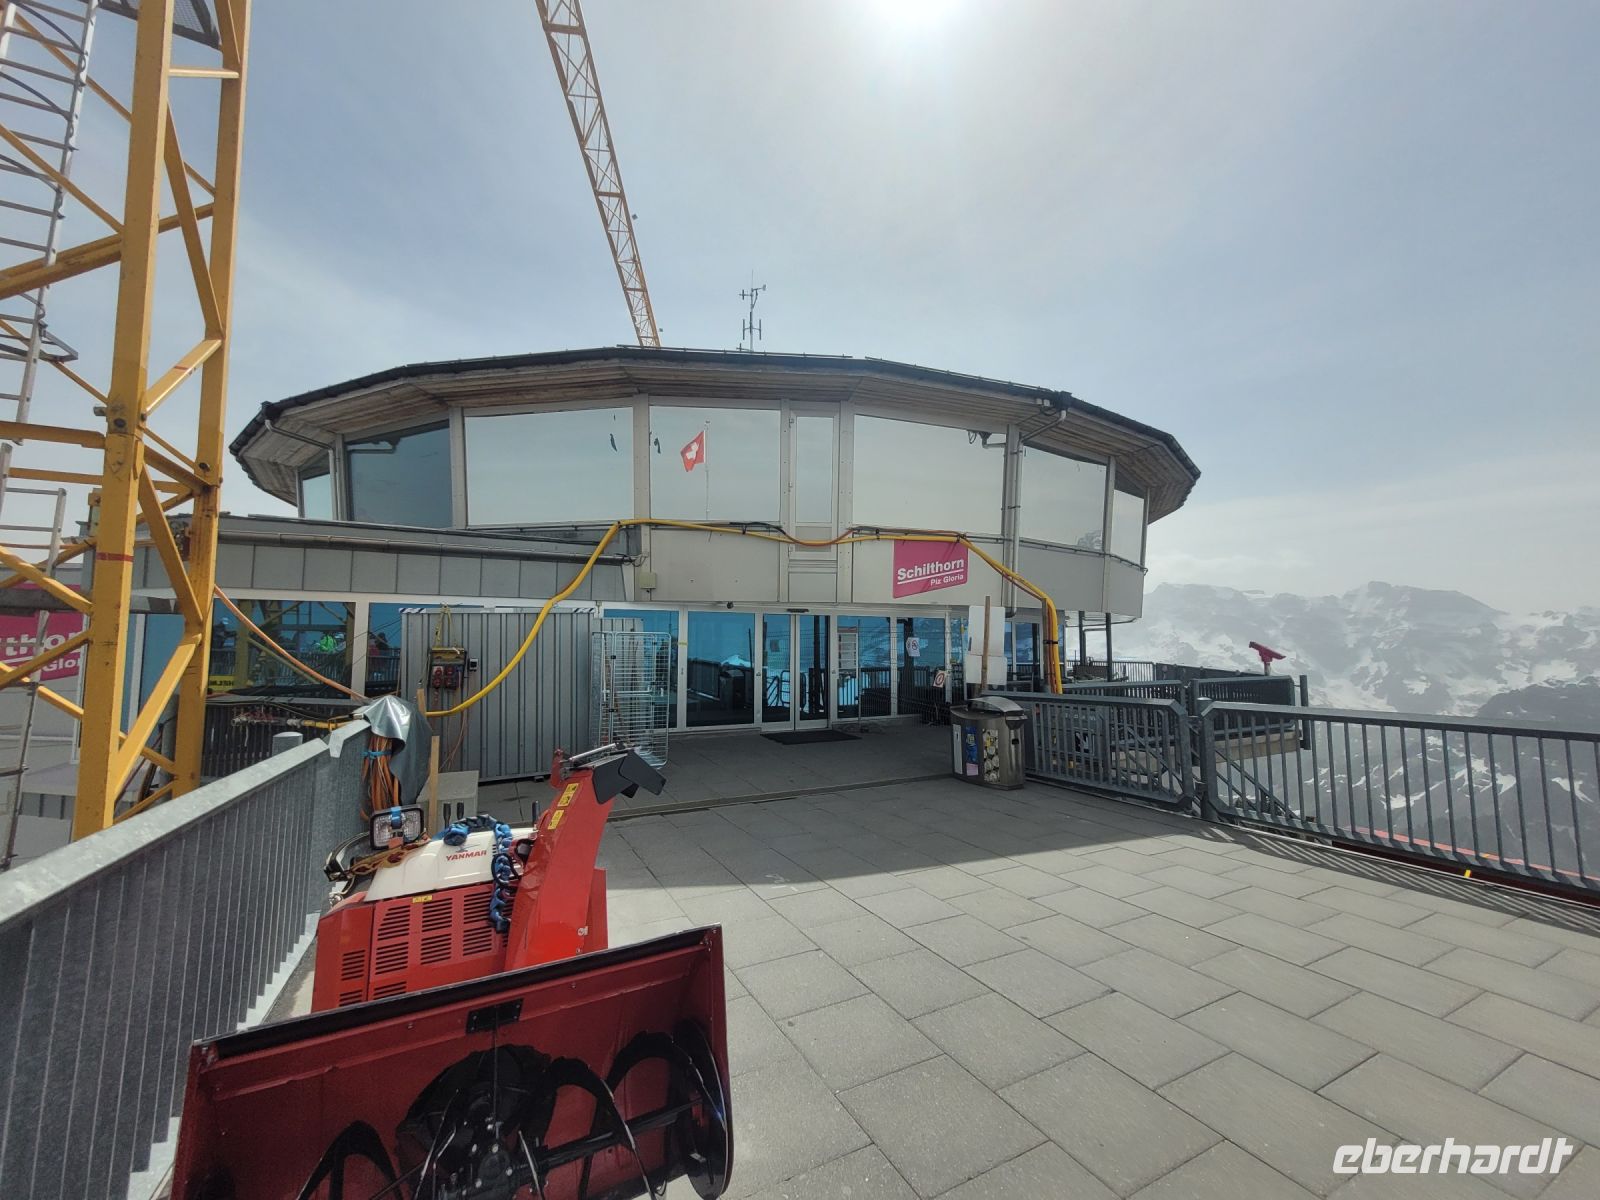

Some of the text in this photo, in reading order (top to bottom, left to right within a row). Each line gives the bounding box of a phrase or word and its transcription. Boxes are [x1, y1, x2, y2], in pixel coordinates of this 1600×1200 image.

[897, 559, 964, 581] Schilthorn
[930, 573, 964, 587] Piz Gloria
[446, 850, 487, 861] YANMAR
